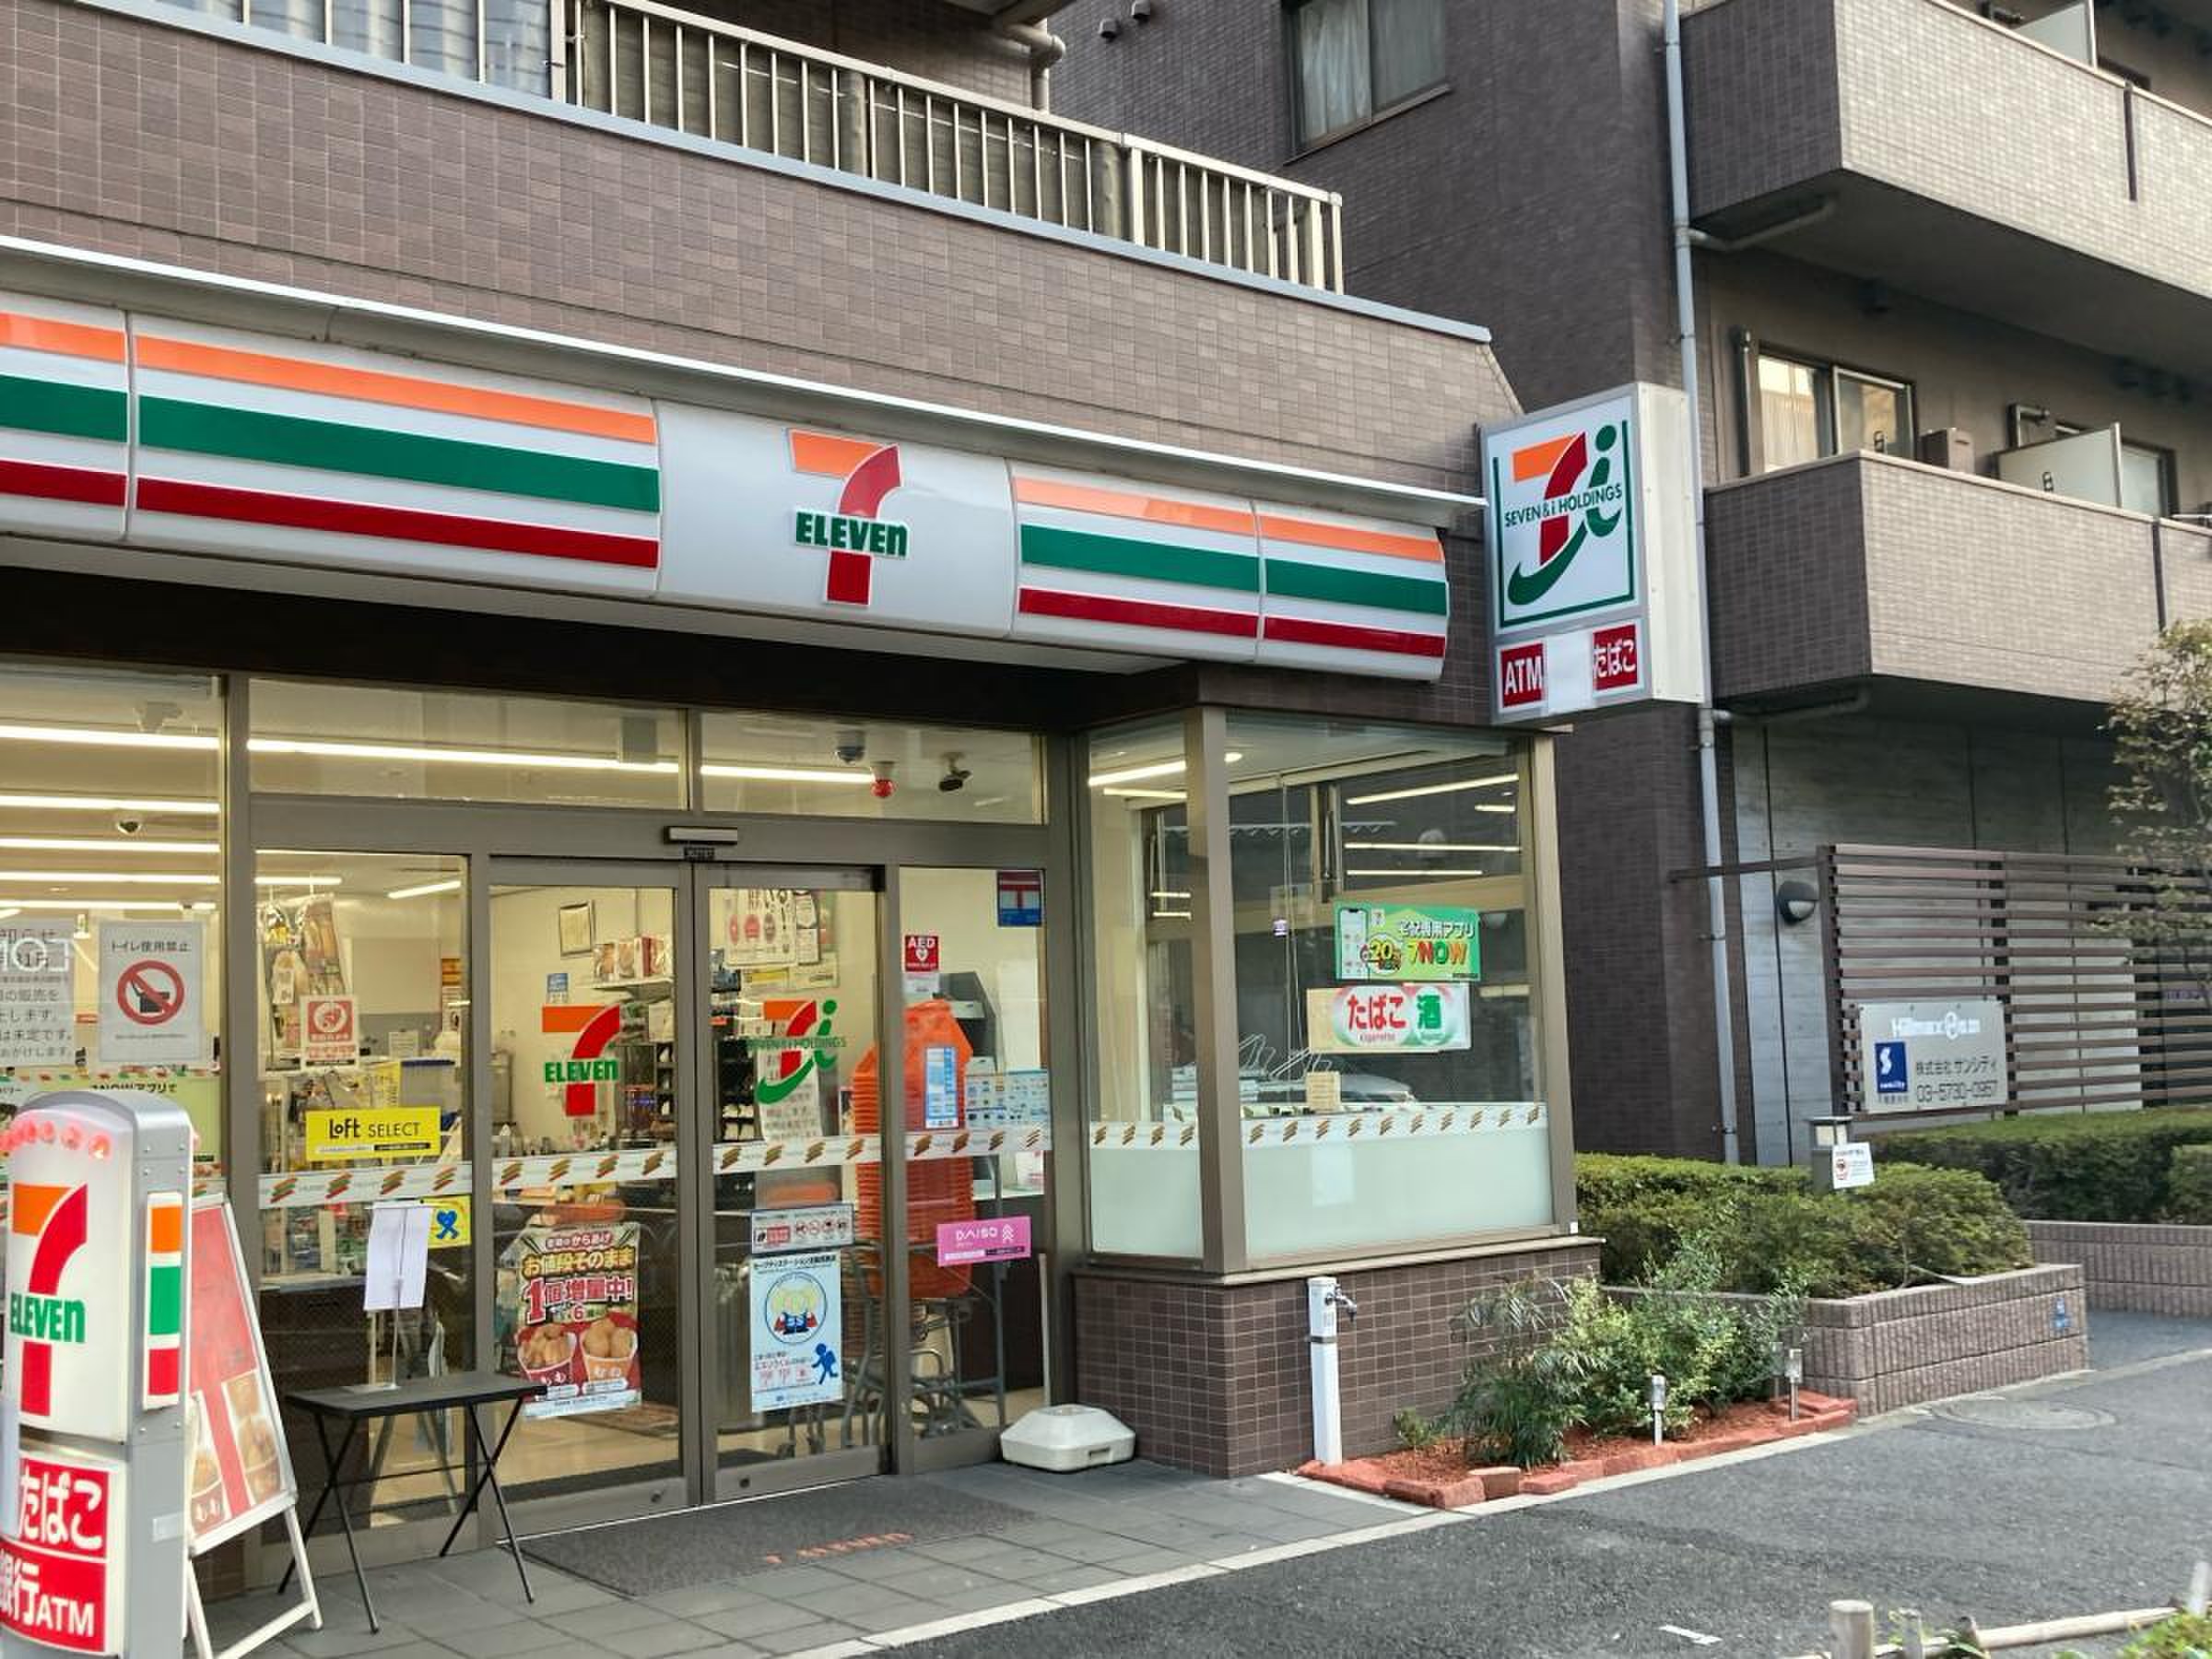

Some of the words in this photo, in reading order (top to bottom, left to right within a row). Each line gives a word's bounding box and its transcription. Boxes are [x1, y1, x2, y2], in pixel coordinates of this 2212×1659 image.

[1559, 483, 1623, 514] HOLDINGS
[1503, 654, 1543, 697] ATM
[112, 940, 191, 952] トイレ使用禁止
[907, 936, 936, 949] AED
[1347, 994, 1407, 1031] たばこ
[1417, 994, 1442, 1030] 酒
[368, 1122, 421, 1138] SELECT
[956, 1227, 998, 1241] DAISO
[18, 1465, 103, 1550] たばこ
